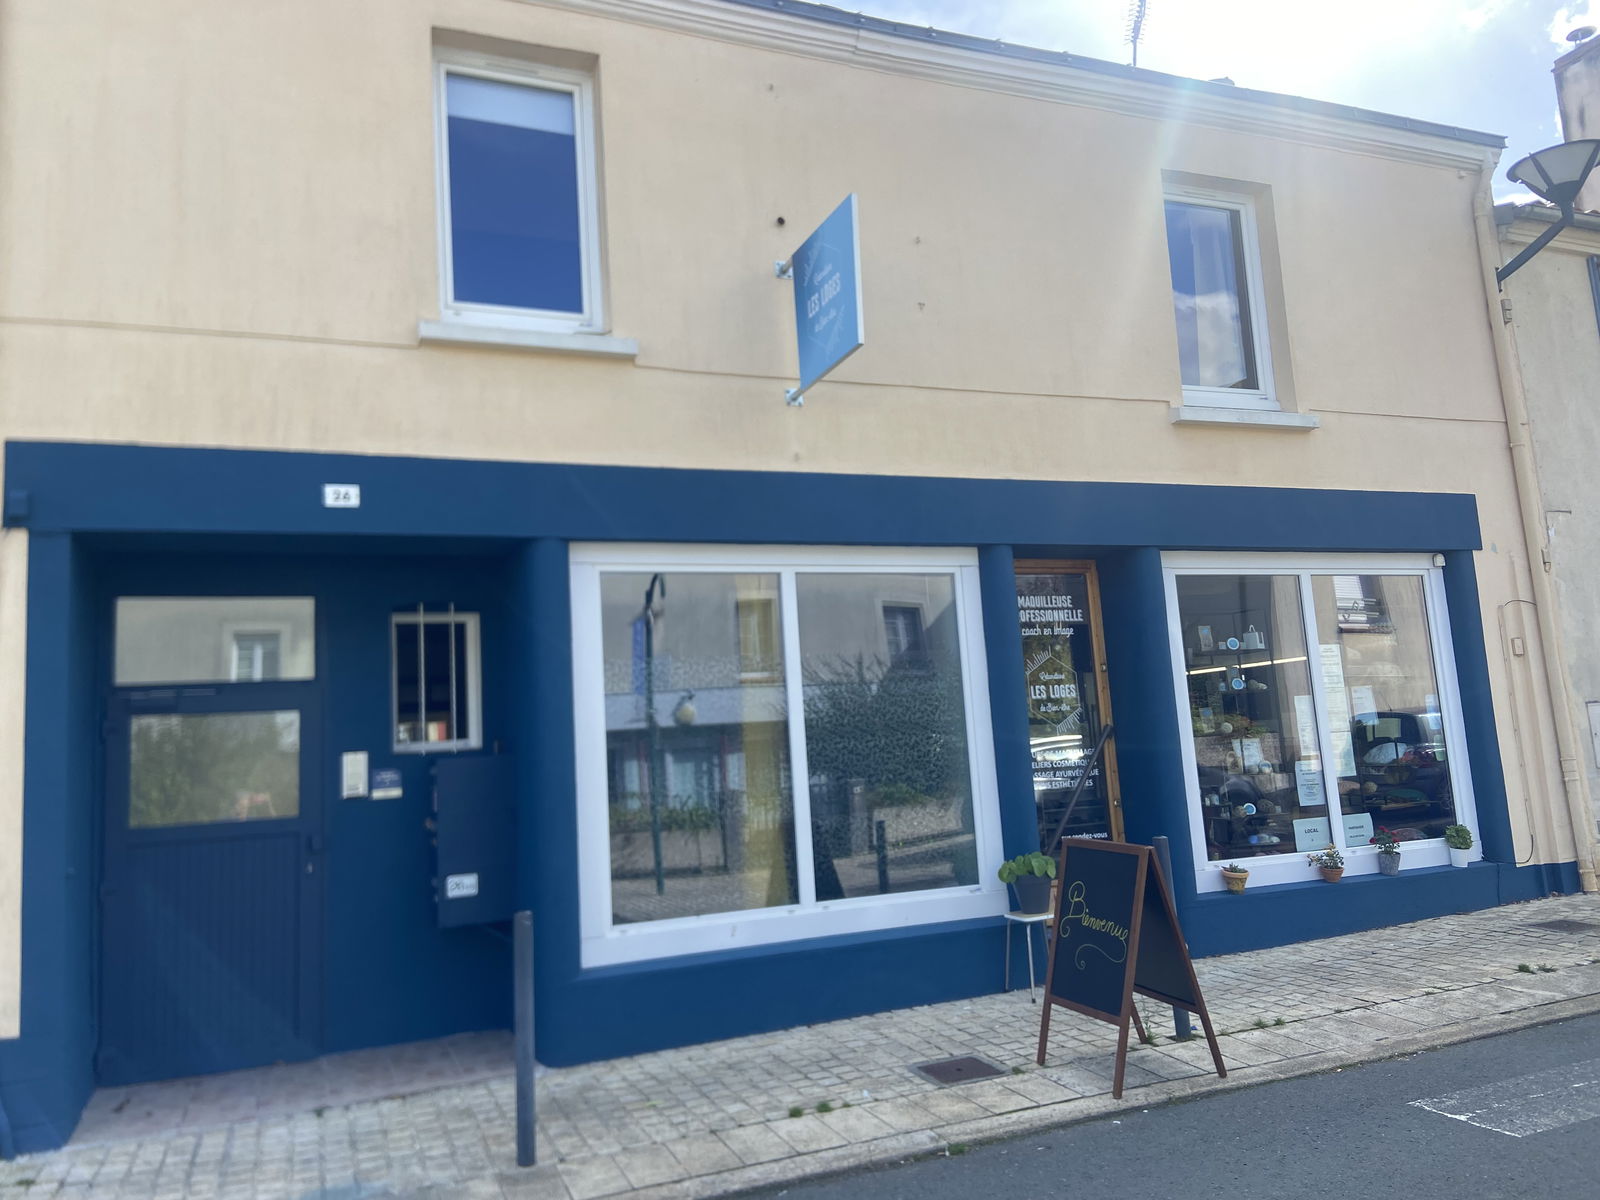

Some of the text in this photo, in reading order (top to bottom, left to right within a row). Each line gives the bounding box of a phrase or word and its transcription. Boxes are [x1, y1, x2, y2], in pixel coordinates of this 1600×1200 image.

[808, 292, 819, 319] LES
[1017, 595, 1073, 608] MAQUILLEUSE
[1019, 609, 1083, 623] OFESSIONNELLE
[1021, 623, 1042, 636] coach
[1030, 684, 1077, 700] LES LOGES
[1031, 760, 1052, 769] ELIERS
[1033, 771, 1054, 779] SSAGE
[1060, 880, 1129, 941] Bienvenue
